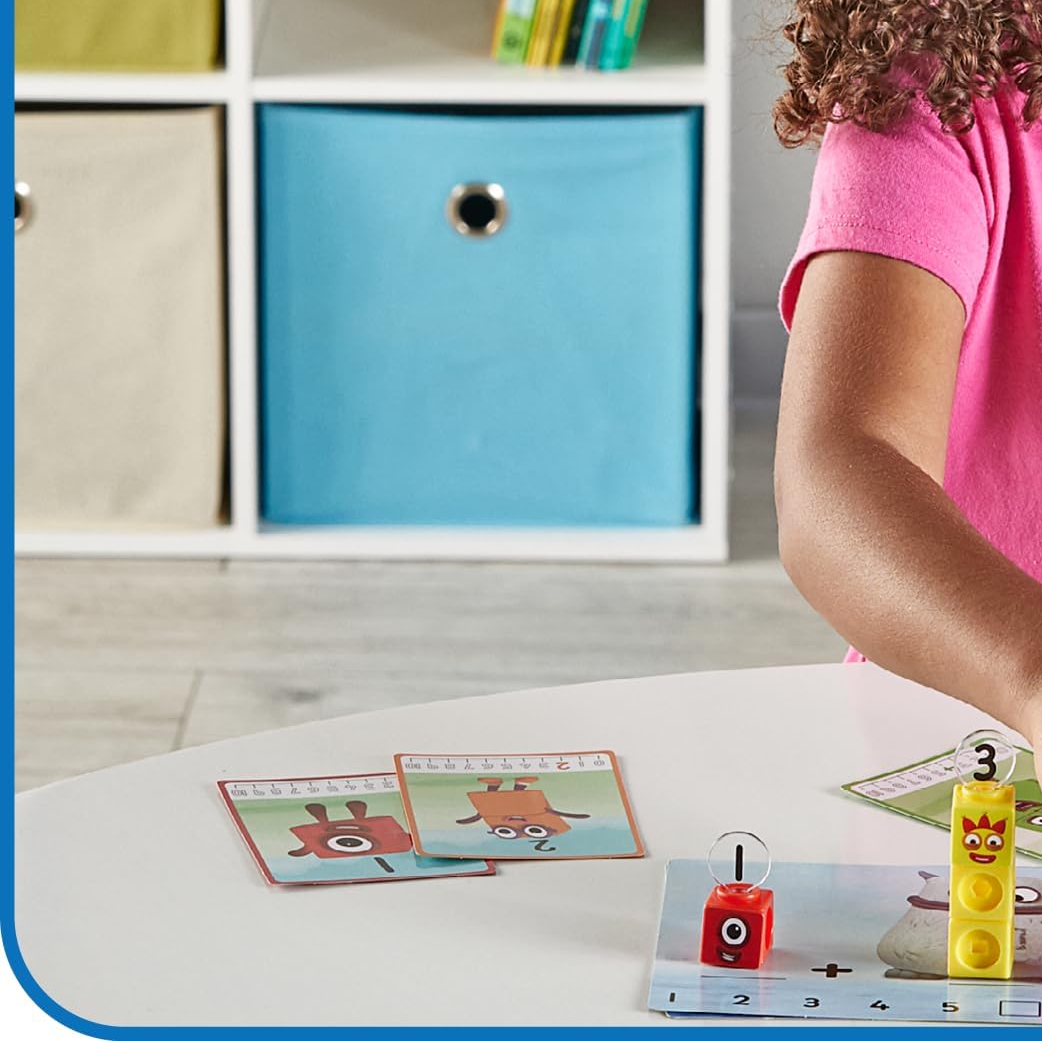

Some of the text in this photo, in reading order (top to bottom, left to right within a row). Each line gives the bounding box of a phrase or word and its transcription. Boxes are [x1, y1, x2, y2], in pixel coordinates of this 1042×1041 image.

[973, 743, 997, 781] 3
[528, 839, 556, 852] 2
[735, 844, 743, 882] 1
[669, 991, 676, 1003] 1
[733, 994, 750, 1006] 2
[803, 997, 820, 1008] 3
[870, 999, 890, 1011] 4
[942, 1001, 960, 1013] 5
